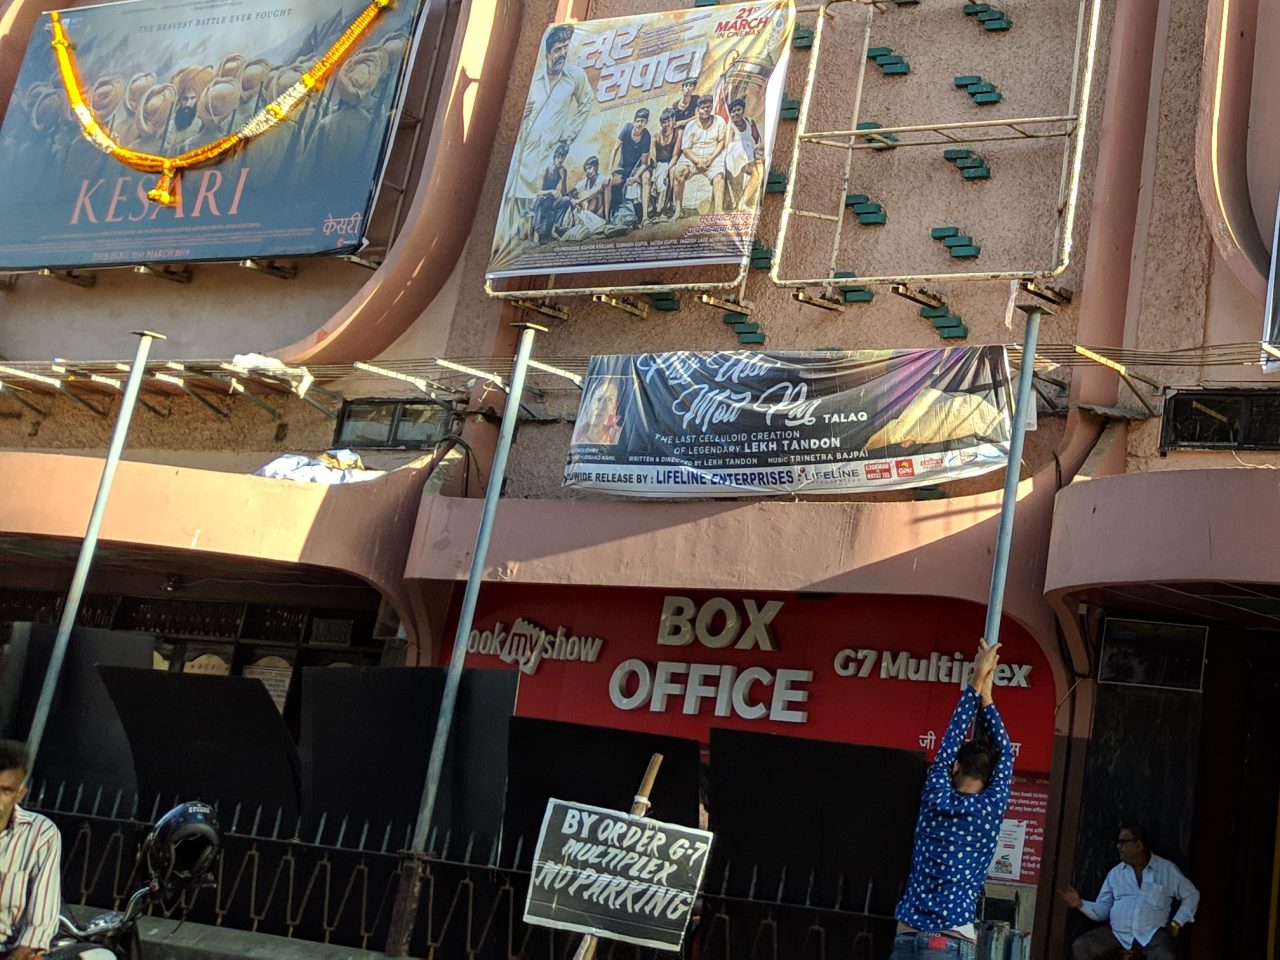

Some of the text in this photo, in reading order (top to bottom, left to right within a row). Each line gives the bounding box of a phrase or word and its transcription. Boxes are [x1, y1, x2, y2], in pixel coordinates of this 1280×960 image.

[195, 16, 227, 26] BATTLE
[230, 13, 252, 23] EVER
[256, 8, 293, 20] FOUGHT
[715, 16, 769, 34] MARCH
[70, 168, 250, 224] KESARI
[323, 211, 363, 235] केसरी
[823, 411, 868, 424] TALAQ
[655, 431, 800, 444] THE LAST CELLULOID CREATION
[674, 437, 841, 455] OF LEGENDARY LEKH TANDON
[726, 457, 758, 465] TANDON
[790, 453, 834, 463] TRINETRA
[836, 450, 869, 459] BAJPAI
[595, 470, 794, 486] RELEASE BY LIFELINE ENTERPRISES
[657, 596, 784, 652] BOX
[466, 617, 603, 675] ookmyshow
[834, 649, 1032, 691] G7 Multipex
[609, 659, 813, 723] OFFICE
[561, 809, 599, 838] BY
[597, 819, 666, 857] ORDER
[562, 838, 677, 886] MULTIPLEX
[535, 861, 691, 920] NO PARKING
